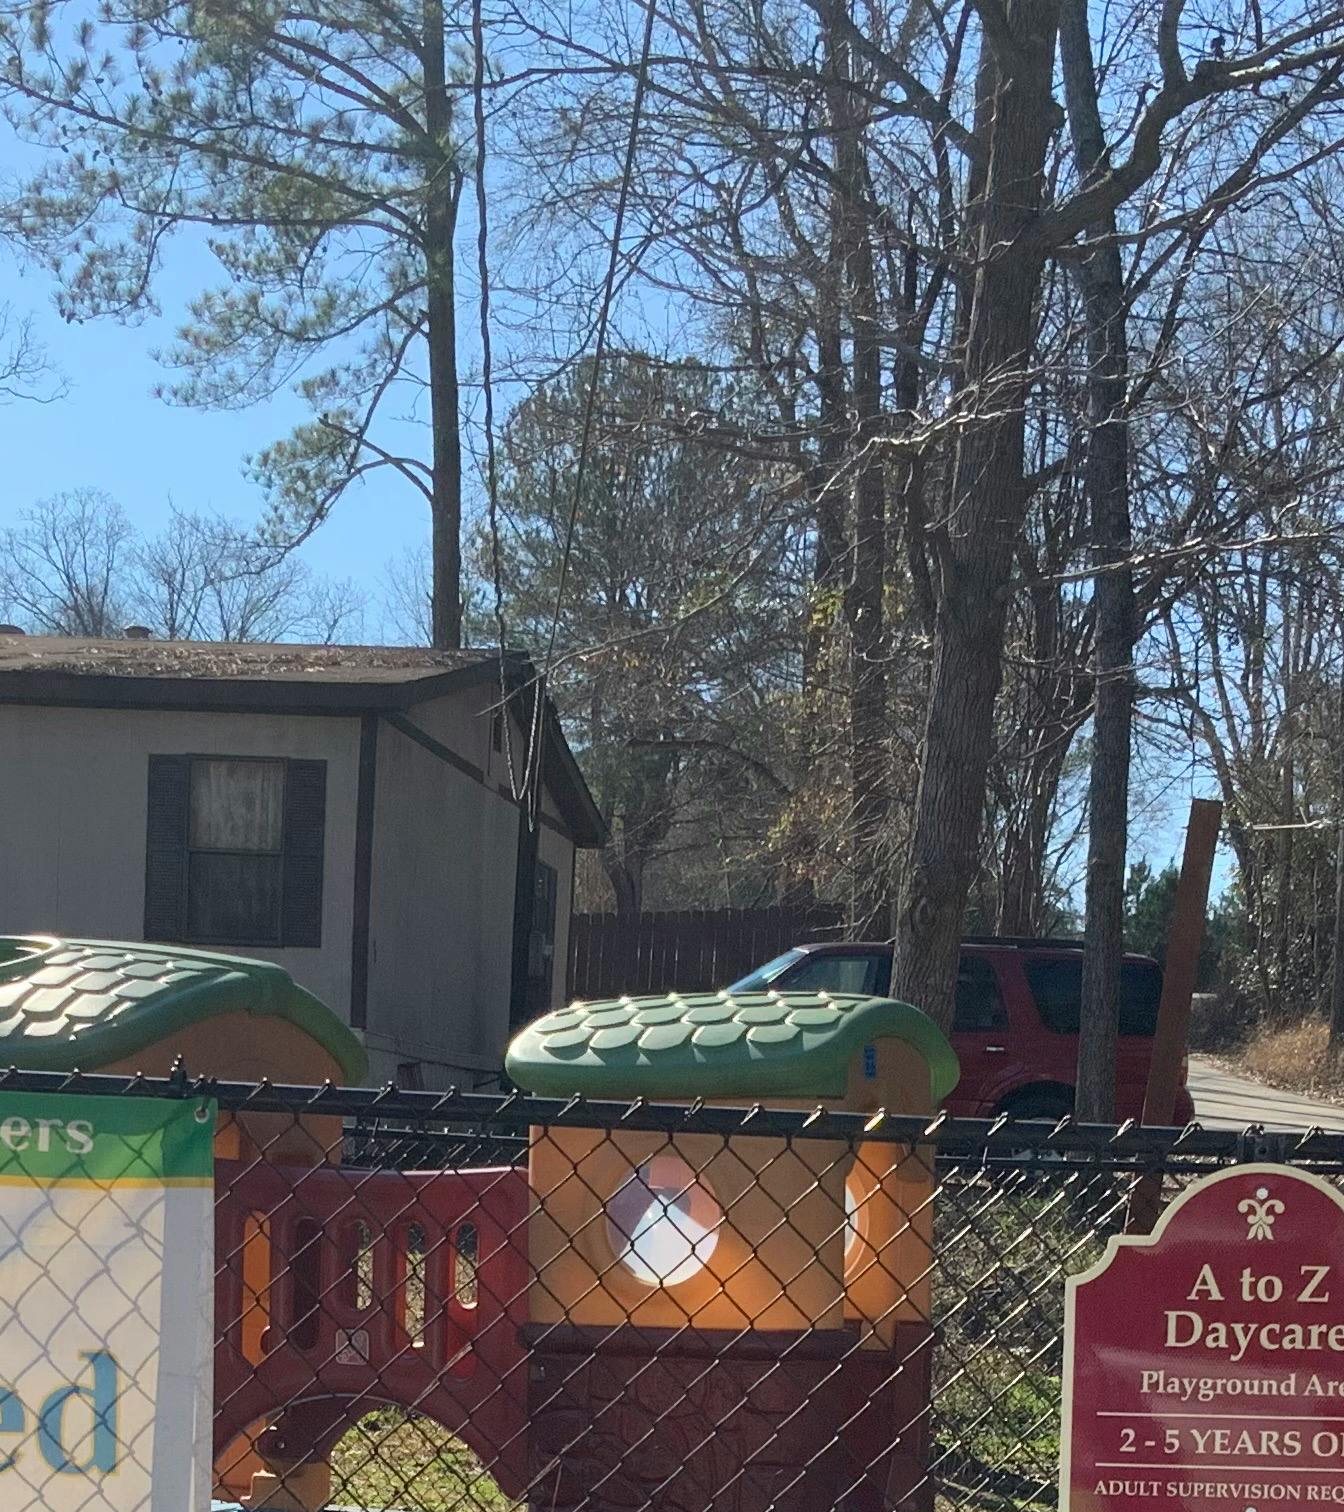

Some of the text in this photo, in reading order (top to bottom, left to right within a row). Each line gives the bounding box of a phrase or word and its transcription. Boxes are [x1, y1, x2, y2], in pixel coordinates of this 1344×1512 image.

[1187, 1264, 1331, 1303] A to Z
[1140, 1371, 1297, 1402] Playground
[1190, 1430, 1302, 1457] YEARS
[1094, 1480, 1162, 1497] ADULT
[1166, 1483, 1302, 1500] SUPERVISION
